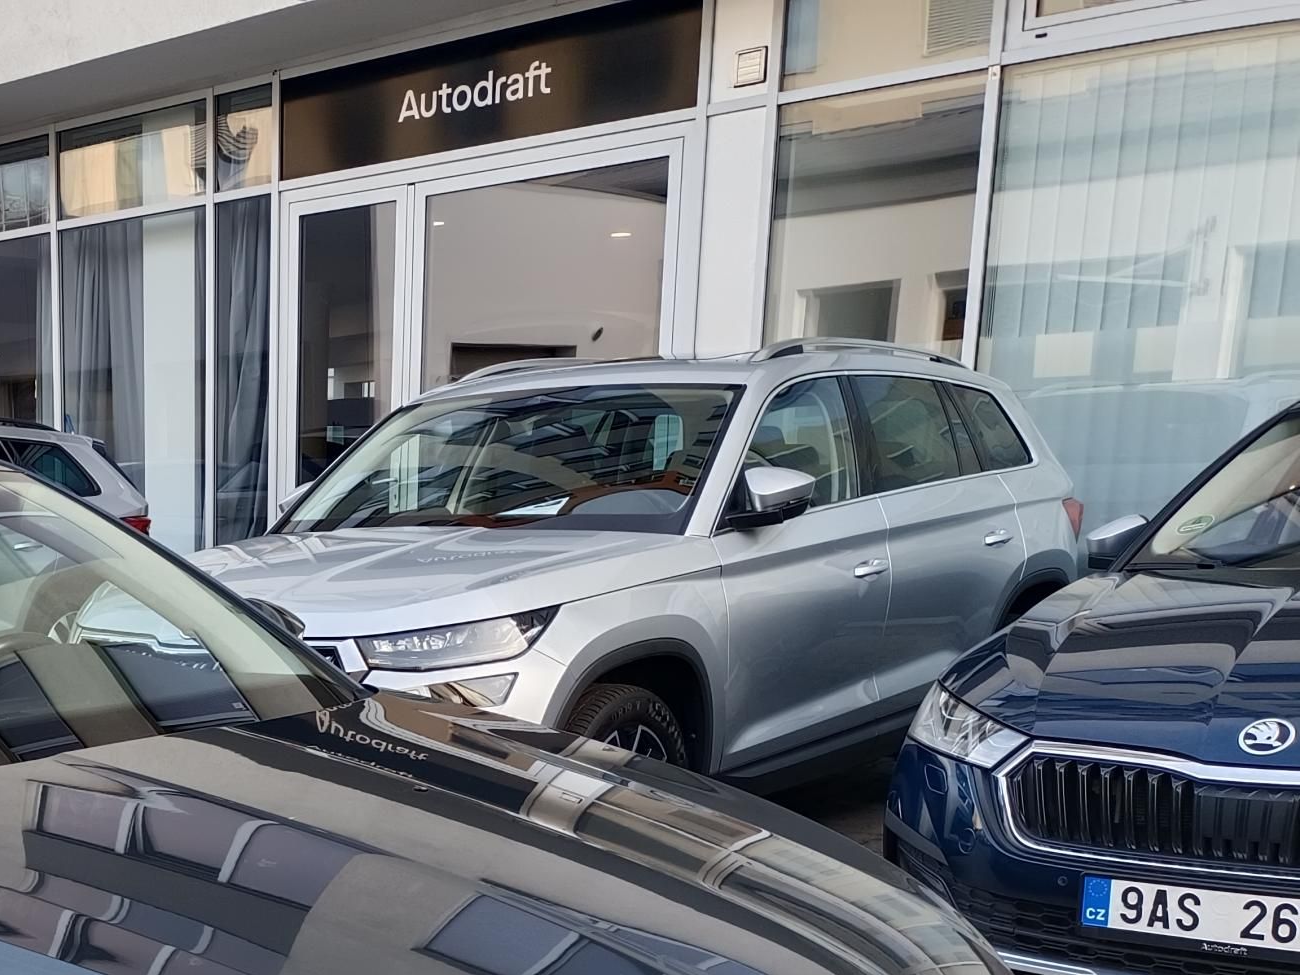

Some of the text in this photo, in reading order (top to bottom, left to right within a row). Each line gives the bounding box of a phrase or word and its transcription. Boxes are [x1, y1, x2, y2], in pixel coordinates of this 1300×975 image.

[398, 60, 552, 123] Autodraft
[1085, 907, 1106, 921] CZ
[1120, 886, 1299, 943] 9AS 26
[1201, 942, 1249, 957] Autodraft
